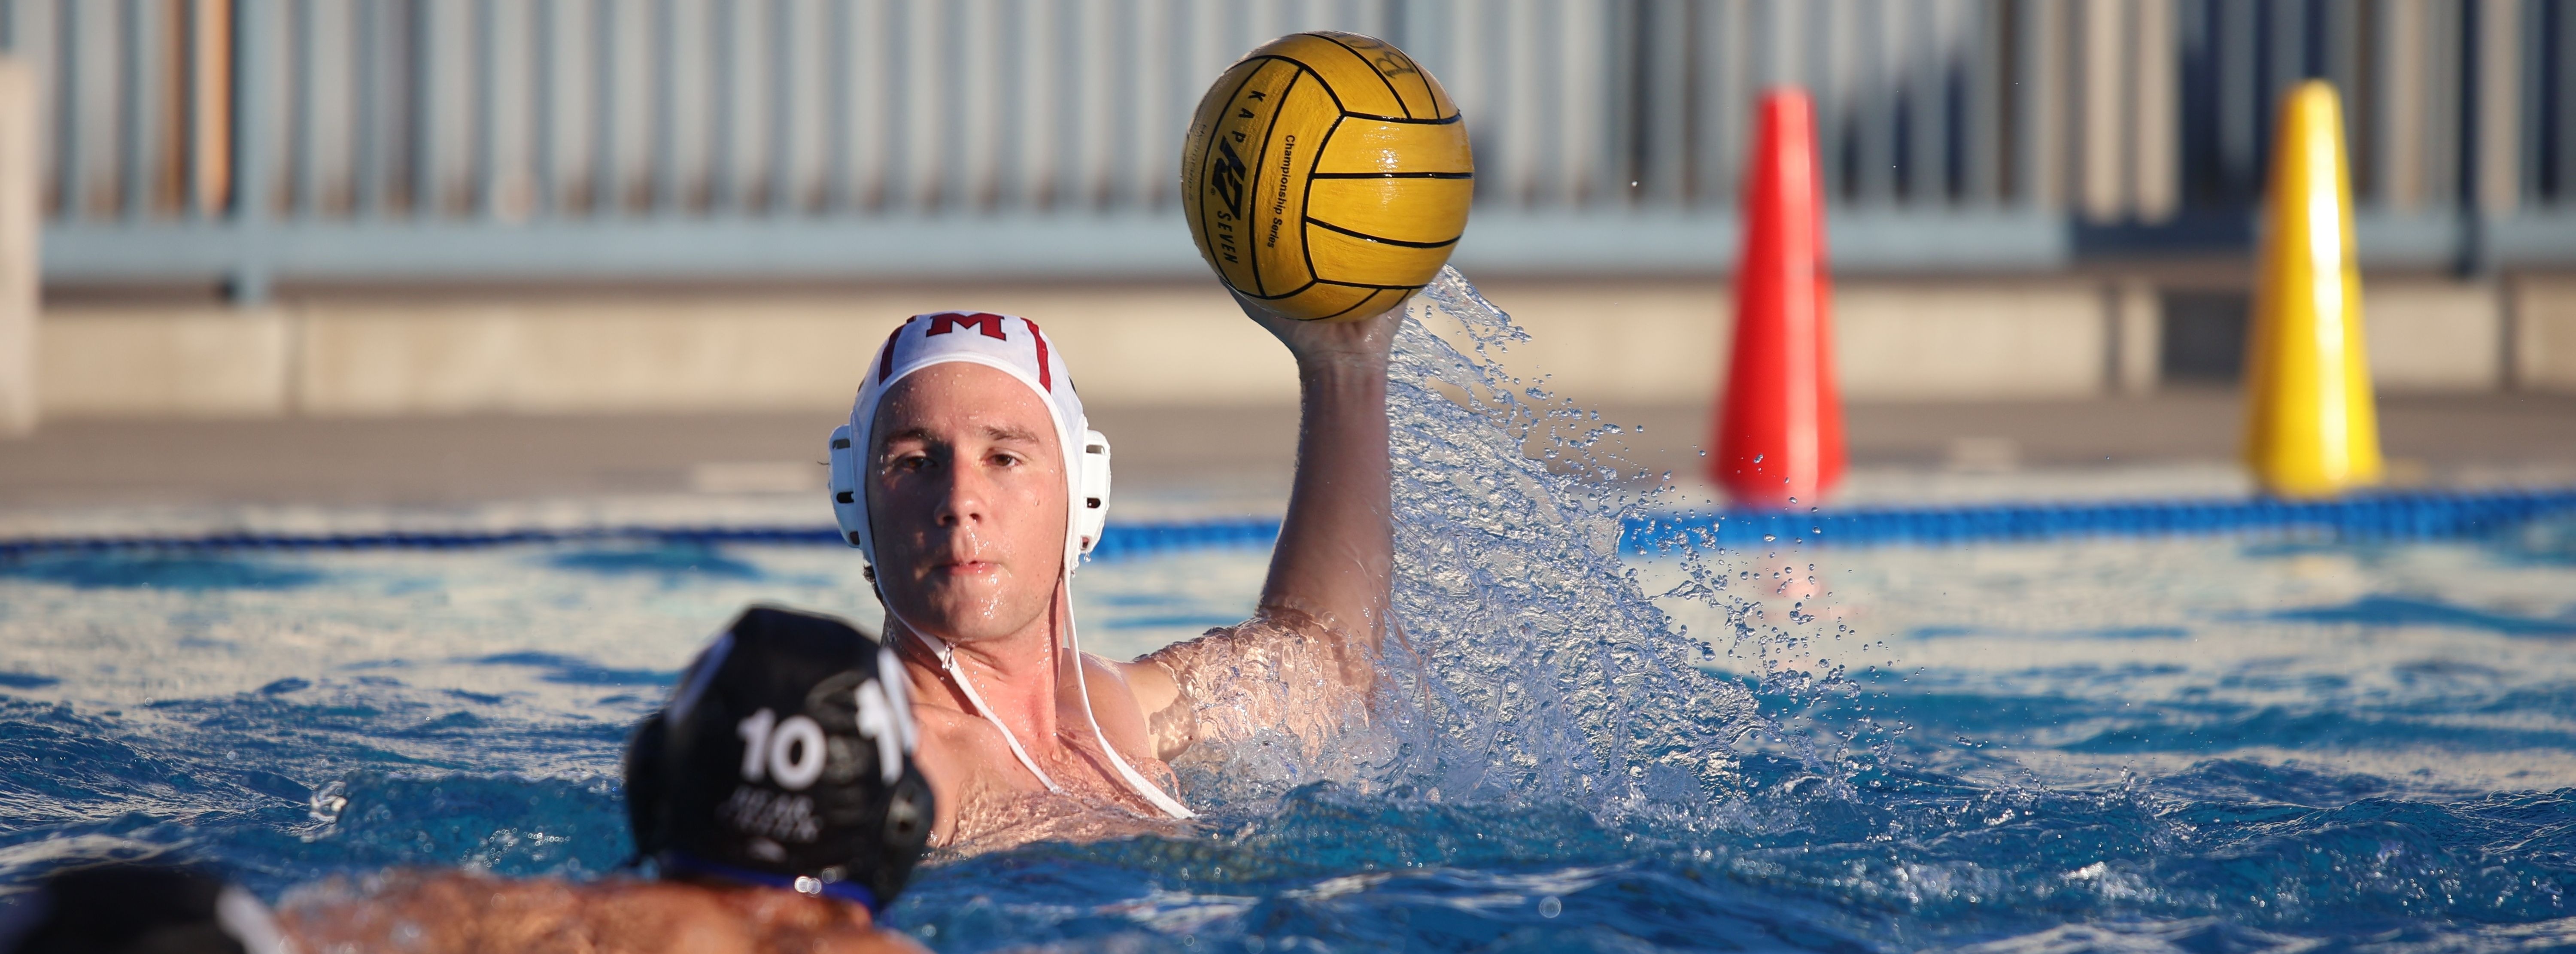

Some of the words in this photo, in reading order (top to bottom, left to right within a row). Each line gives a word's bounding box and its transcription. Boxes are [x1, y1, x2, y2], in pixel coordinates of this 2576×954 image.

[1230, 91, 1266, 143] KAP
[1272, 135, 1295, 215] Championship
[1217, 211, 1238, 264] SEVEN
[1267, 218, 1282, 248] Series
[926, 313, 1006, 341] M
[735, 707, 827, 790] 10
